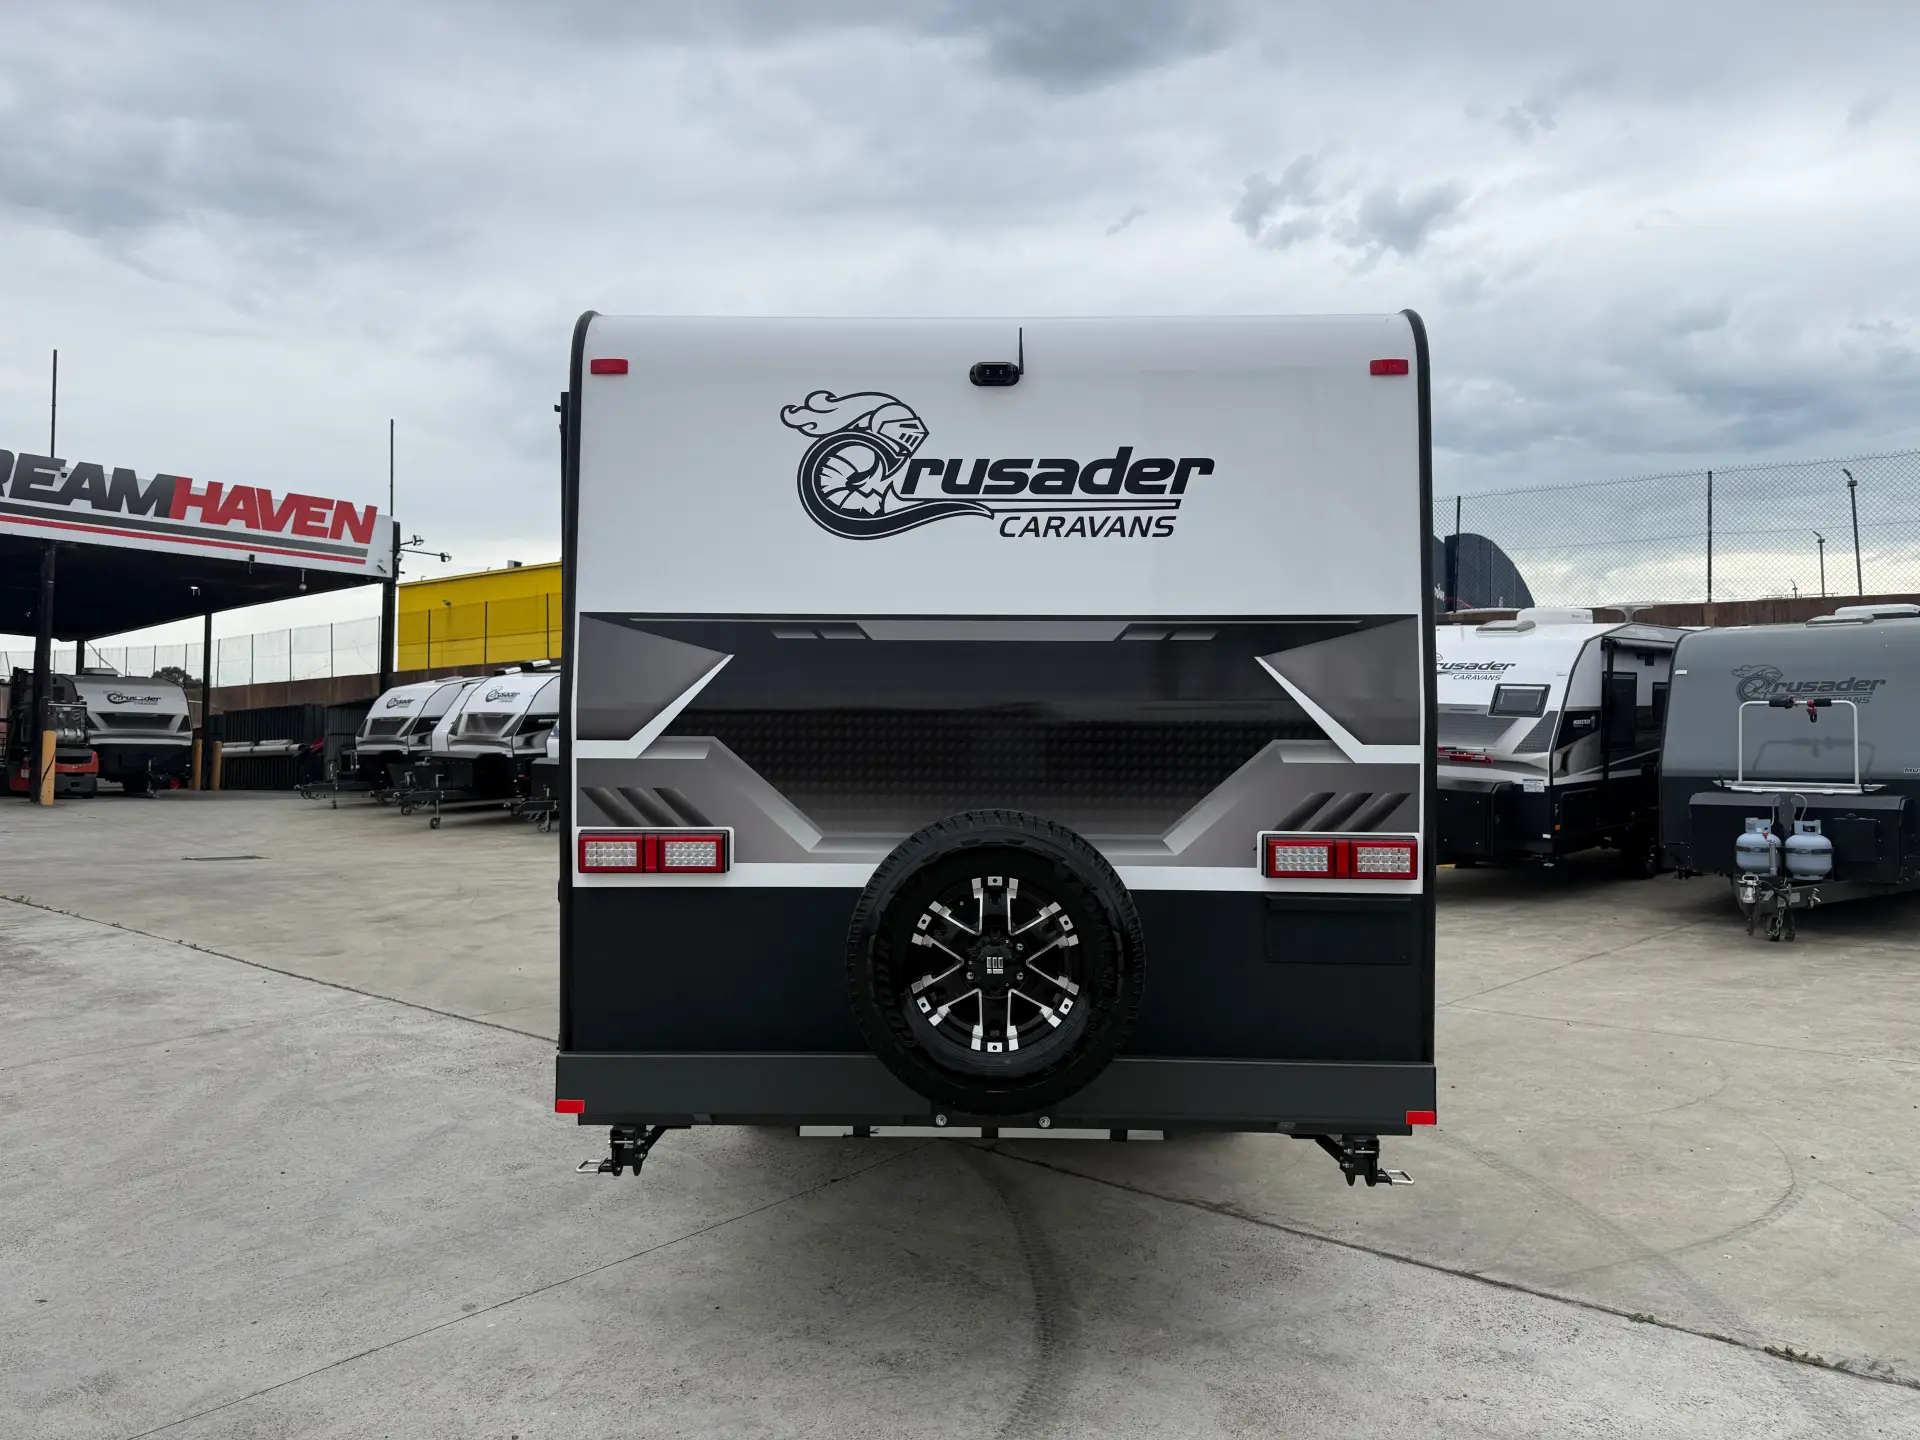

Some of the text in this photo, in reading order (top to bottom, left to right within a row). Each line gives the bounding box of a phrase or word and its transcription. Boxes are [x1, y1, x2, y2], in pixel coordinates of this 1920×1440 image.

[797, 430, 1215, 541] Crusader
[999, 515, 1177, 538] CARAVANS
[1436, 661, 1516, 671] rusader
[1736, 675, 1887, 702] Crusader
